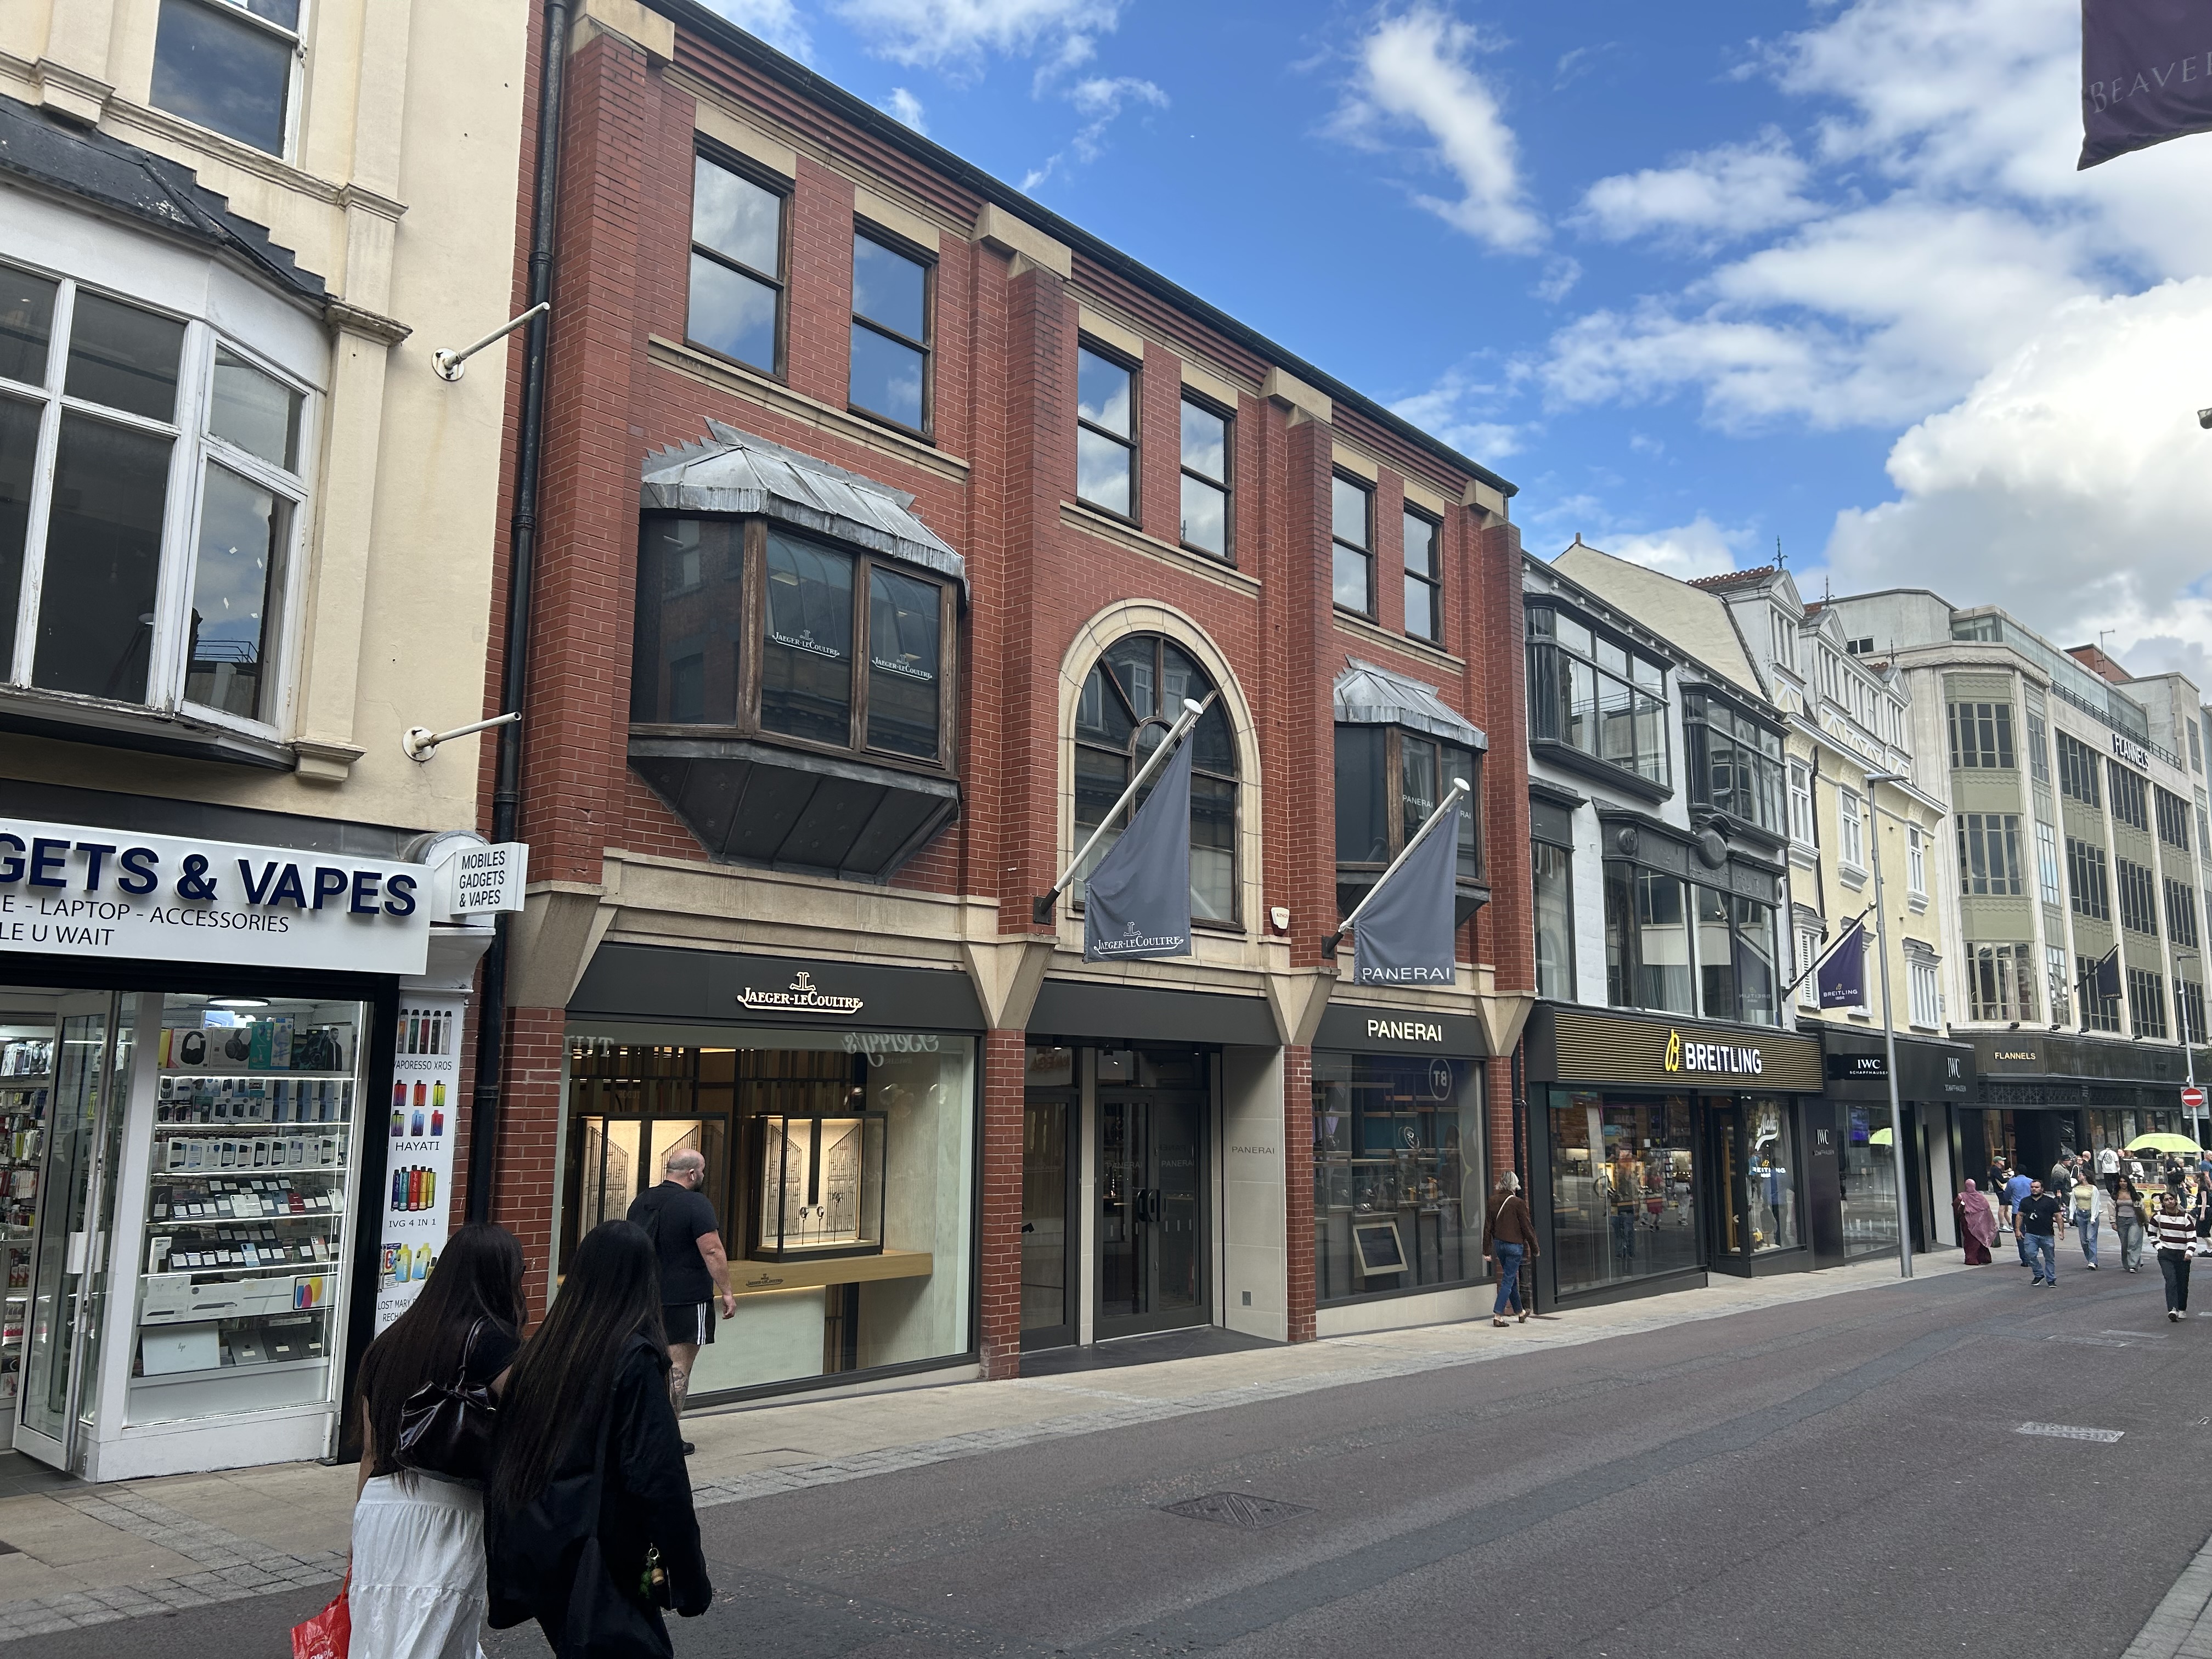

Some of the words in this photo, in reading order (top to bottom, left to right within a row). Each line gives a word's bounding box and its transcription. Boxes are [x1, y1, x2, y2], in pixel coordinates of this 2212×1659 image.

[2112, 733, 2149, 770] FLANNELS
[1403, 794, 1433, 808] PANERAI
[461, 850, 505, 870] MOBILES
[176, 854, 218, 901] &
[237, 859, 417, 916] VAPES
[459, 870, 505, 889] GADGETS
[459, 893, 466, 907] &
[469, 889, 500, 906] VAPES
[40, 898, 130, 920] LAPTOP
[150, 906, 289, 933] ACCESSORIES
[32, 925, 48, 942] U
[55, 926, 115, 946] WAIT
[1093, 935, 1184, 955] JAEGER-LECOULTRE
[1362, 967, 1450, 980] PANERAI
[737, 987, 864, 1014] JAEGER-LECOULTRE
[1368, 1019, 1442, 1041] PANERAI
[433, 1061, 452, 1070] XROS
[1685, 1042, 1762, 1074] BREITLING
[1857, 1059, 1881, 1069] IWC
[1994, 1052, 2036, 1060] FLANNELS
[1948, 1057, 1961, 1078] IWC
[396, 1141, 439, 1151] HAYATI
[1817, 1129, 1829, 1145] IWC
[1232, 1146, 1275, 1154] PANERAI
[377, 1301, 393, 1310] LOST
[395, 1299, 411, 1308] MARY
